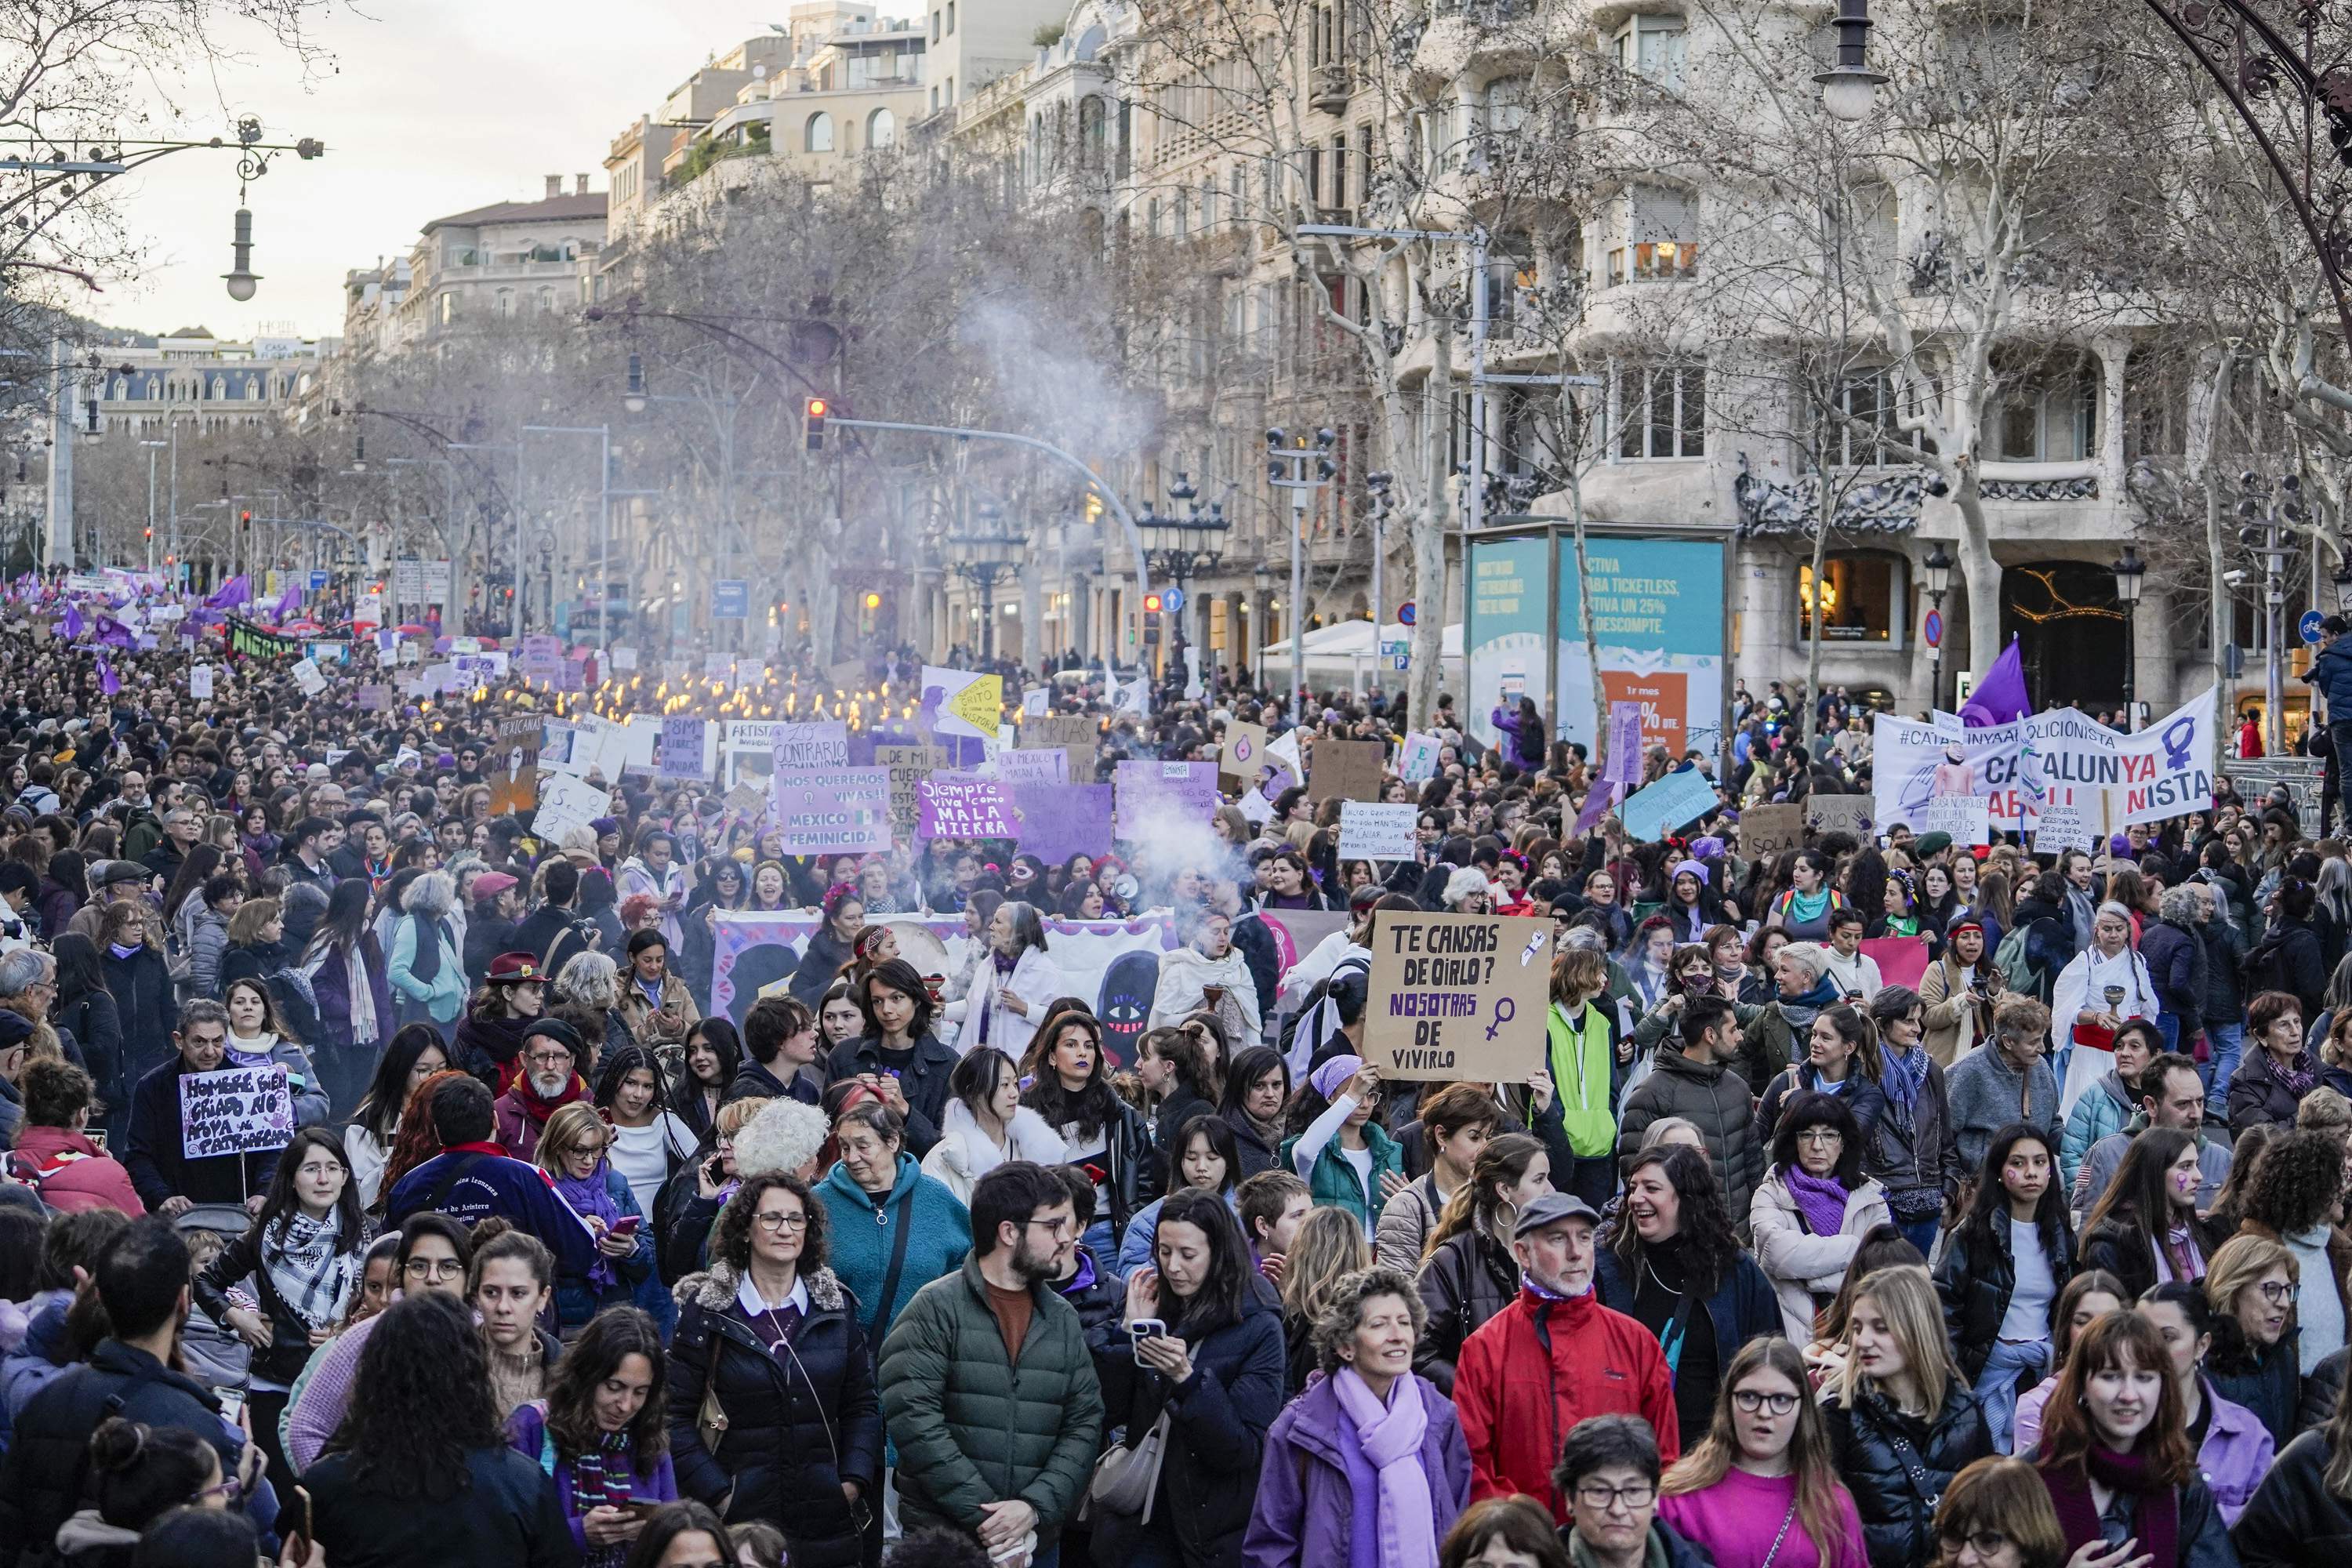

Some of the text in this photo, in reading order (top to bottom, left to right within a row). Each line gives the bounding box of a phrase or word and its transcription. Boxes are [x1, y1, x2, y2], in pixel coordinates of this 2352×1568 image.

[1587, 557, 1620, 573] CTIVA
[1612, 578, 1680, 597] TICKETLESS,
[1621, 598, 1637, 613] UN
[1639, 598, 1667, 615] 25%
[1596, 616, 1665, 634] DESCOMPTE.
[961, 690, 992, 706] GRITO
[499, 716, 543, 738] MEXICANAS
[672, 719, 696, 735] 8M
[962, 711, 998, 734] HISTORIA
[1062, 719, 1090, 743] LAS
[667, 739, 695, 750] LIBRES
[774, 741, 847, 764] CONTRARIO
[889, 750, 903, 764] DE
[1000, 755, 1012, 766] EN
[1018, 753, 1051, 764] MEXICO
[664, 760, 701, 773] UNIDAS
[1005, 766, 1033, 779] MATAN
[1036, 766, 1044, 778] A
[1985, 752, 2156, 784] CAALUNYA
[784, 774, 884, 787] NOS QUEREMOS
[921, 781, 996, 802] Siempre
[931, 797, 1004, 808] viva como
[789, 813, 848, 826] MEXICO
[937, 806, 1000, 822] MALA
[1827, 813, 1848, 828] NO
[2041, 816, 2070, 826] NECESITAN
[934, 821, 1008, 835] HIERBA
[1404, 832, 1415, 840] NO
[789, 831, 877, 845] FEMINICIDA
[1390, 924, 1500, 954] TE CANSAS
[1404, 959, 1428, 986] DE
[1390, 993, 1477, 1017] NOSOTRAS
[1415, 1021, 1442, 1047] DE
[187, 1072, 255, 1098] HOMBRE
[251, 1093, 278, 1116] NO
[187, 1119, 234, 1142] APOYA
